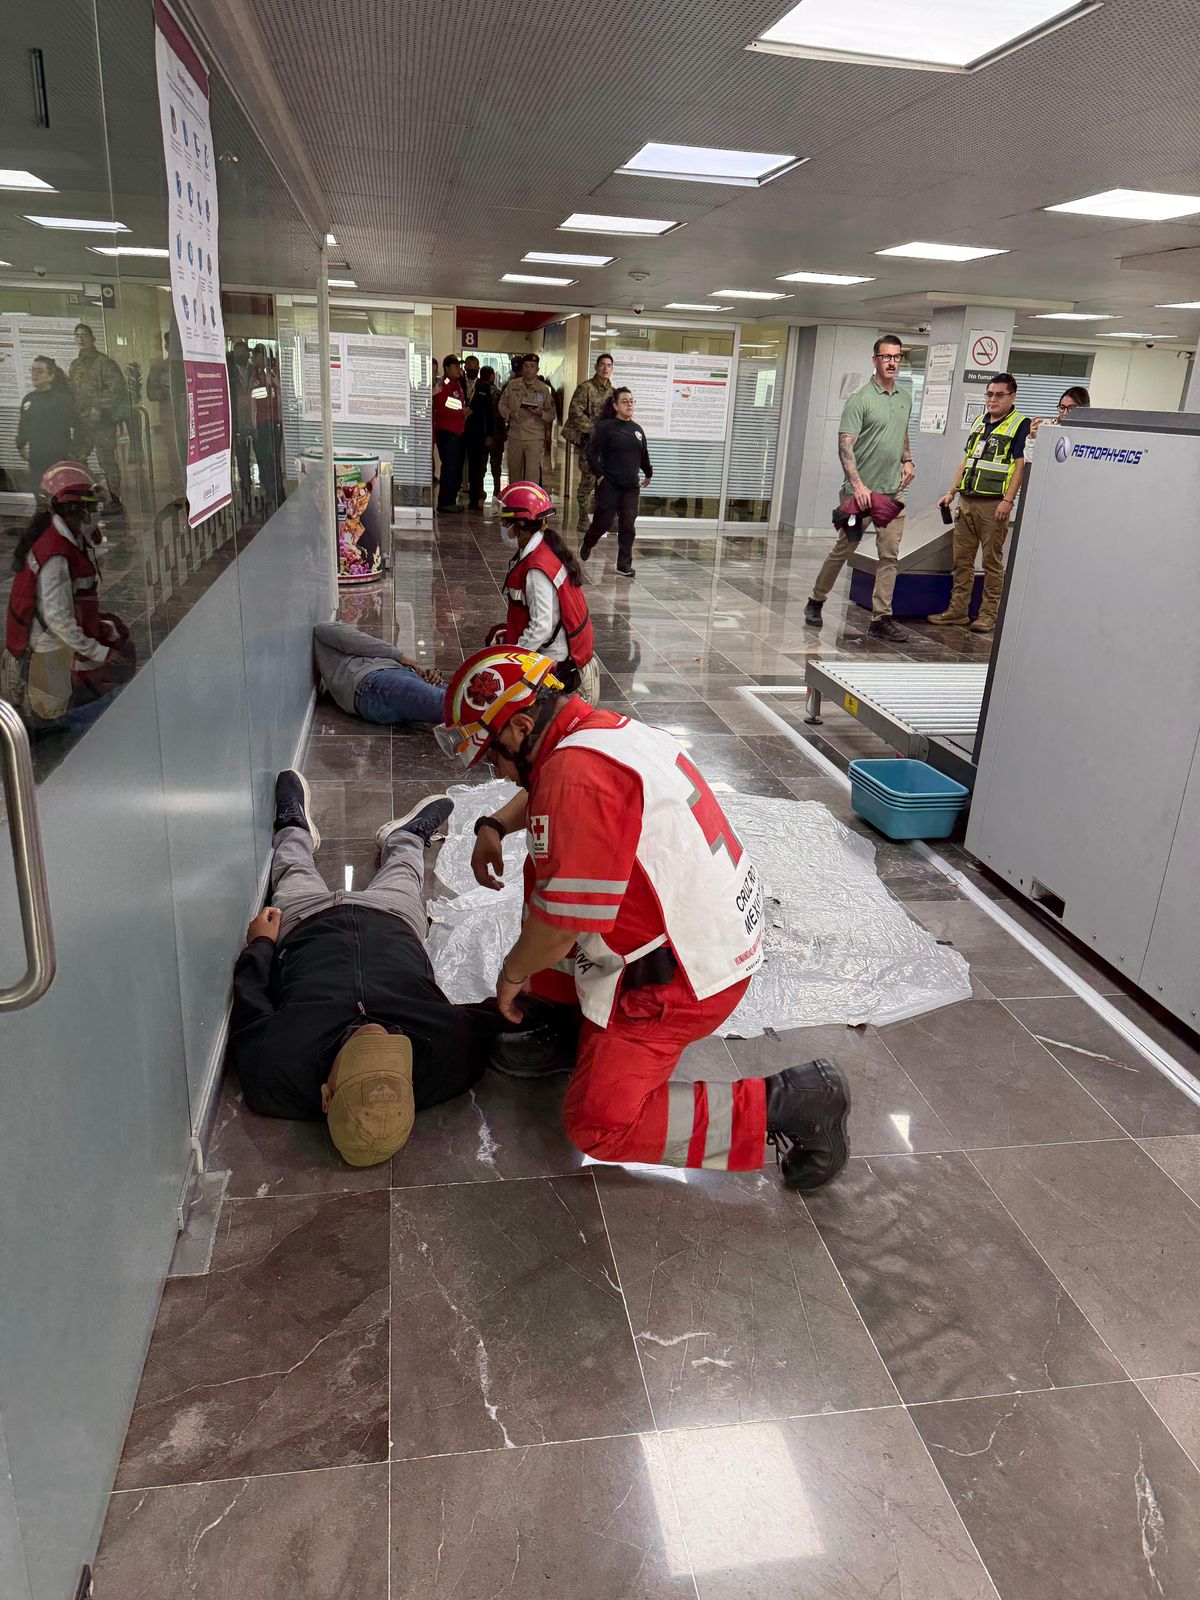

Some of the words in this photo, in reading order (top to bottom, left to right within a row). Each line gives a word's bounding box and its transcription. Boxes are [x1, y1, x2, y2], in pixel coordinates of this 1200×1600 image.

[465, 332, 475, 346] 8
[1071, 444, 1143, 465] ASTROPHYSICS
[736, 877, 753, 912] CRUZ
